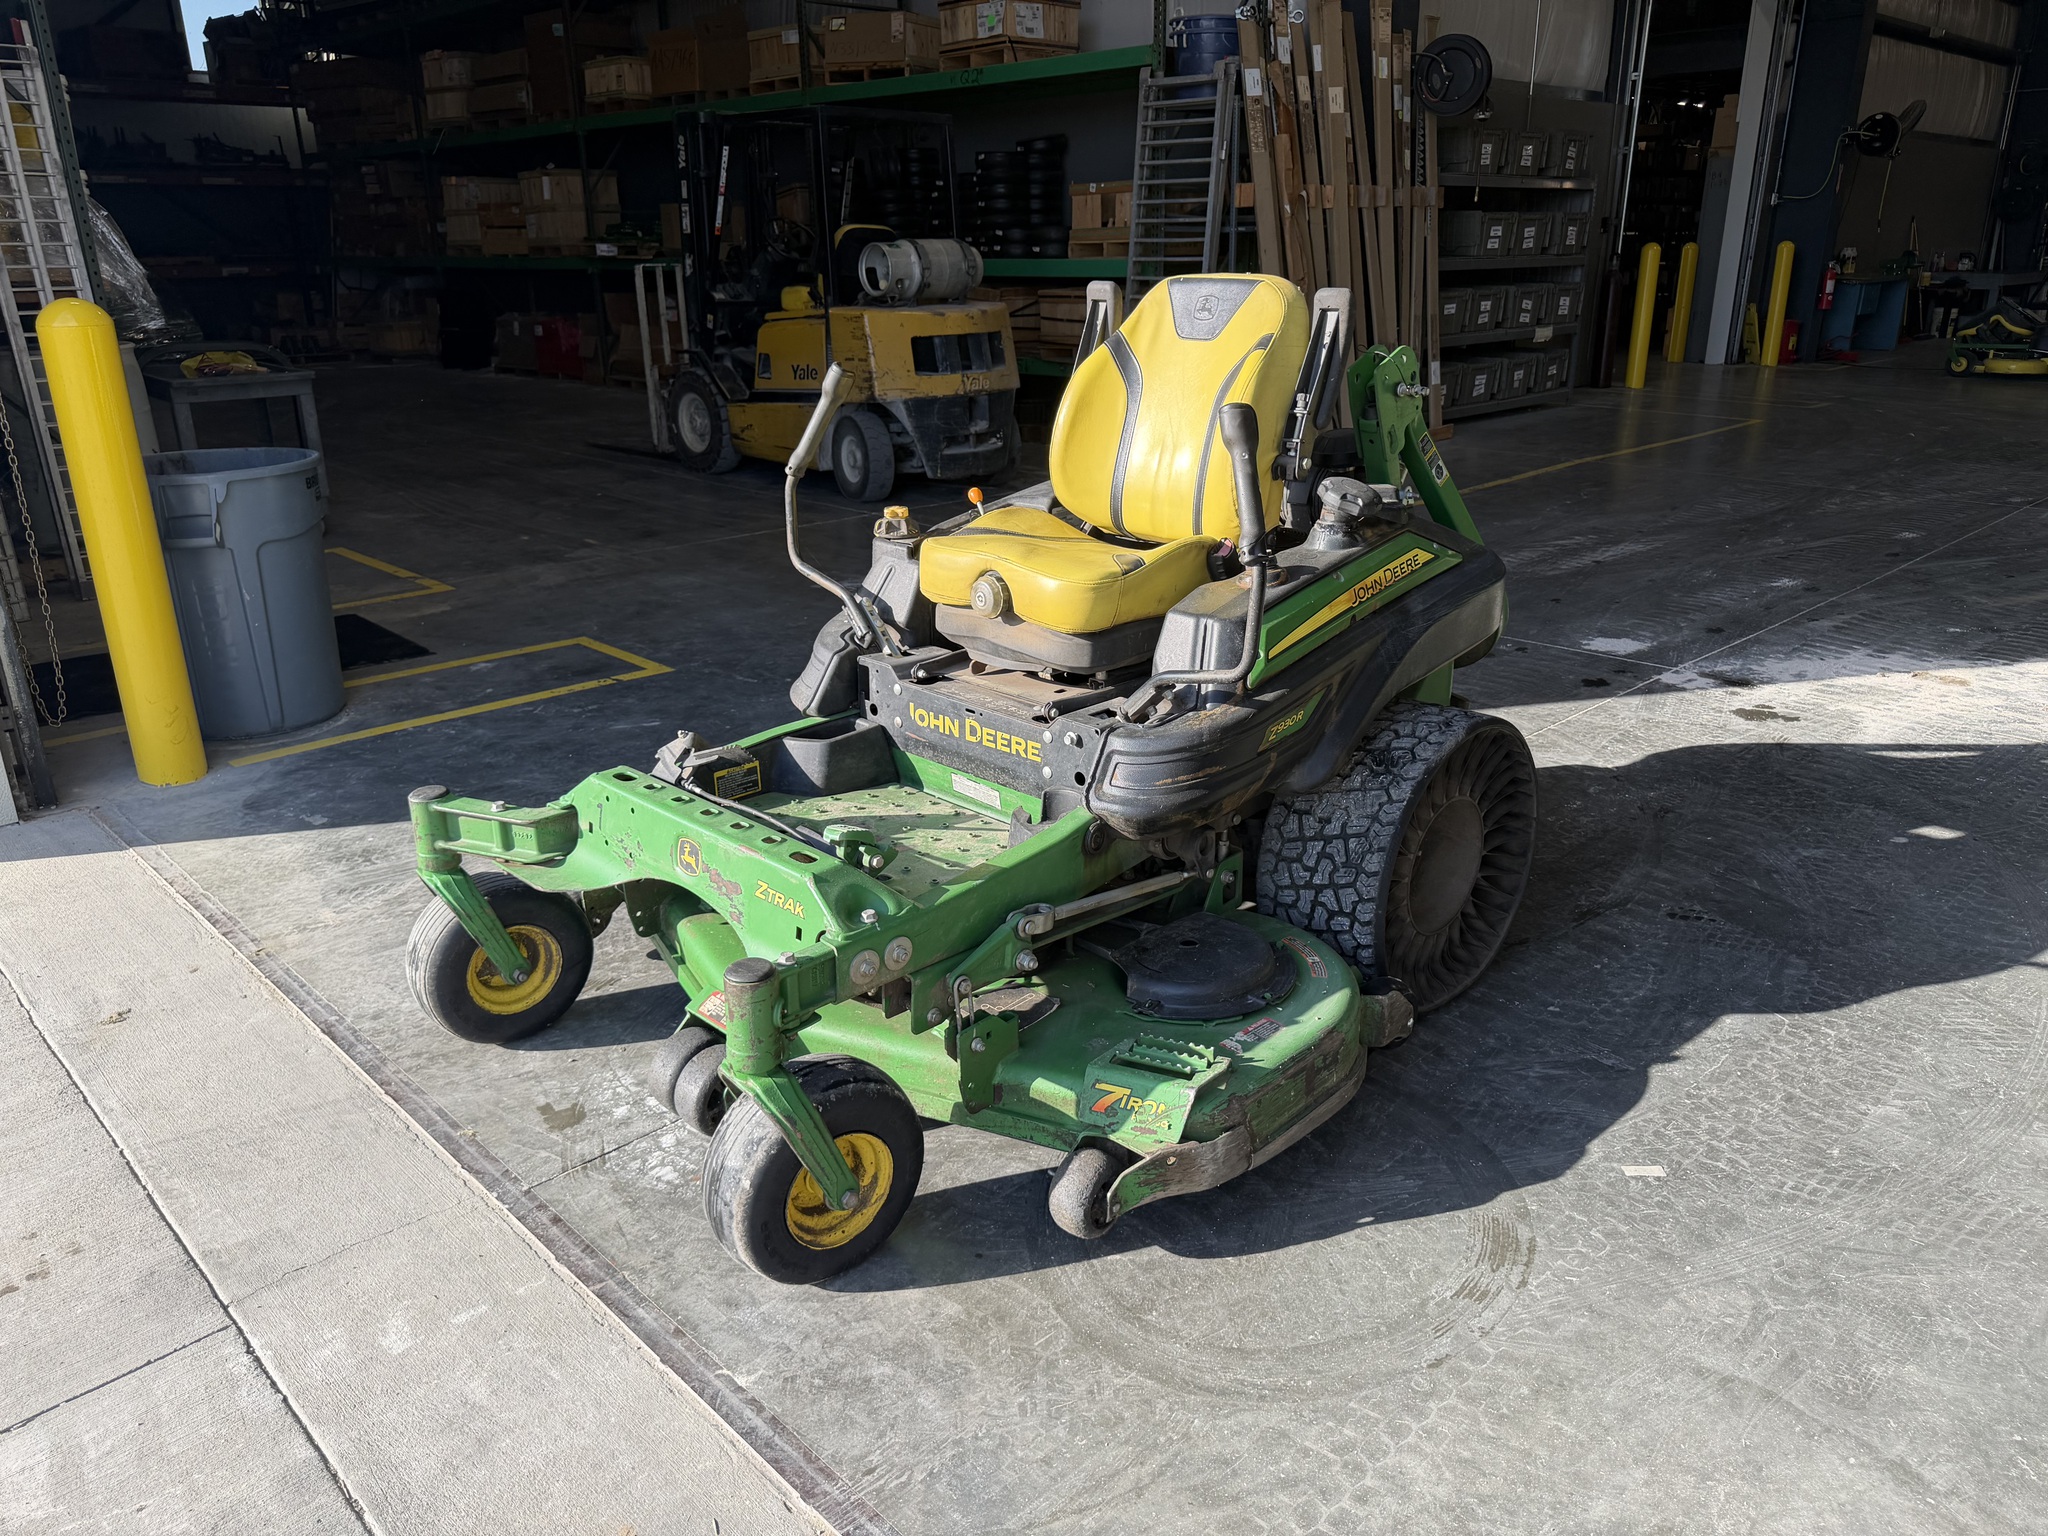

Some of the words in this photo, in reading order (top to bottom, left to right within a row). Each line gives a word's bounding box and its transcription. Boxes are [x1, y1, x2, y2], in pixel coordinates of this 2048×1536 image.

[677, 134, 687, 169] Yale
[791, 364, 818, 380] Yale
[964, 375, 990, 389] Yale
[1352, 576, 1383, 605] JOHN
[1384, 553, 1421, 585] DEERE
[965, 716, 1042, 763] DEERE
[1268, 710, 1304, 741] Z930R
[754, 879, 805, 920] ZTRAK
